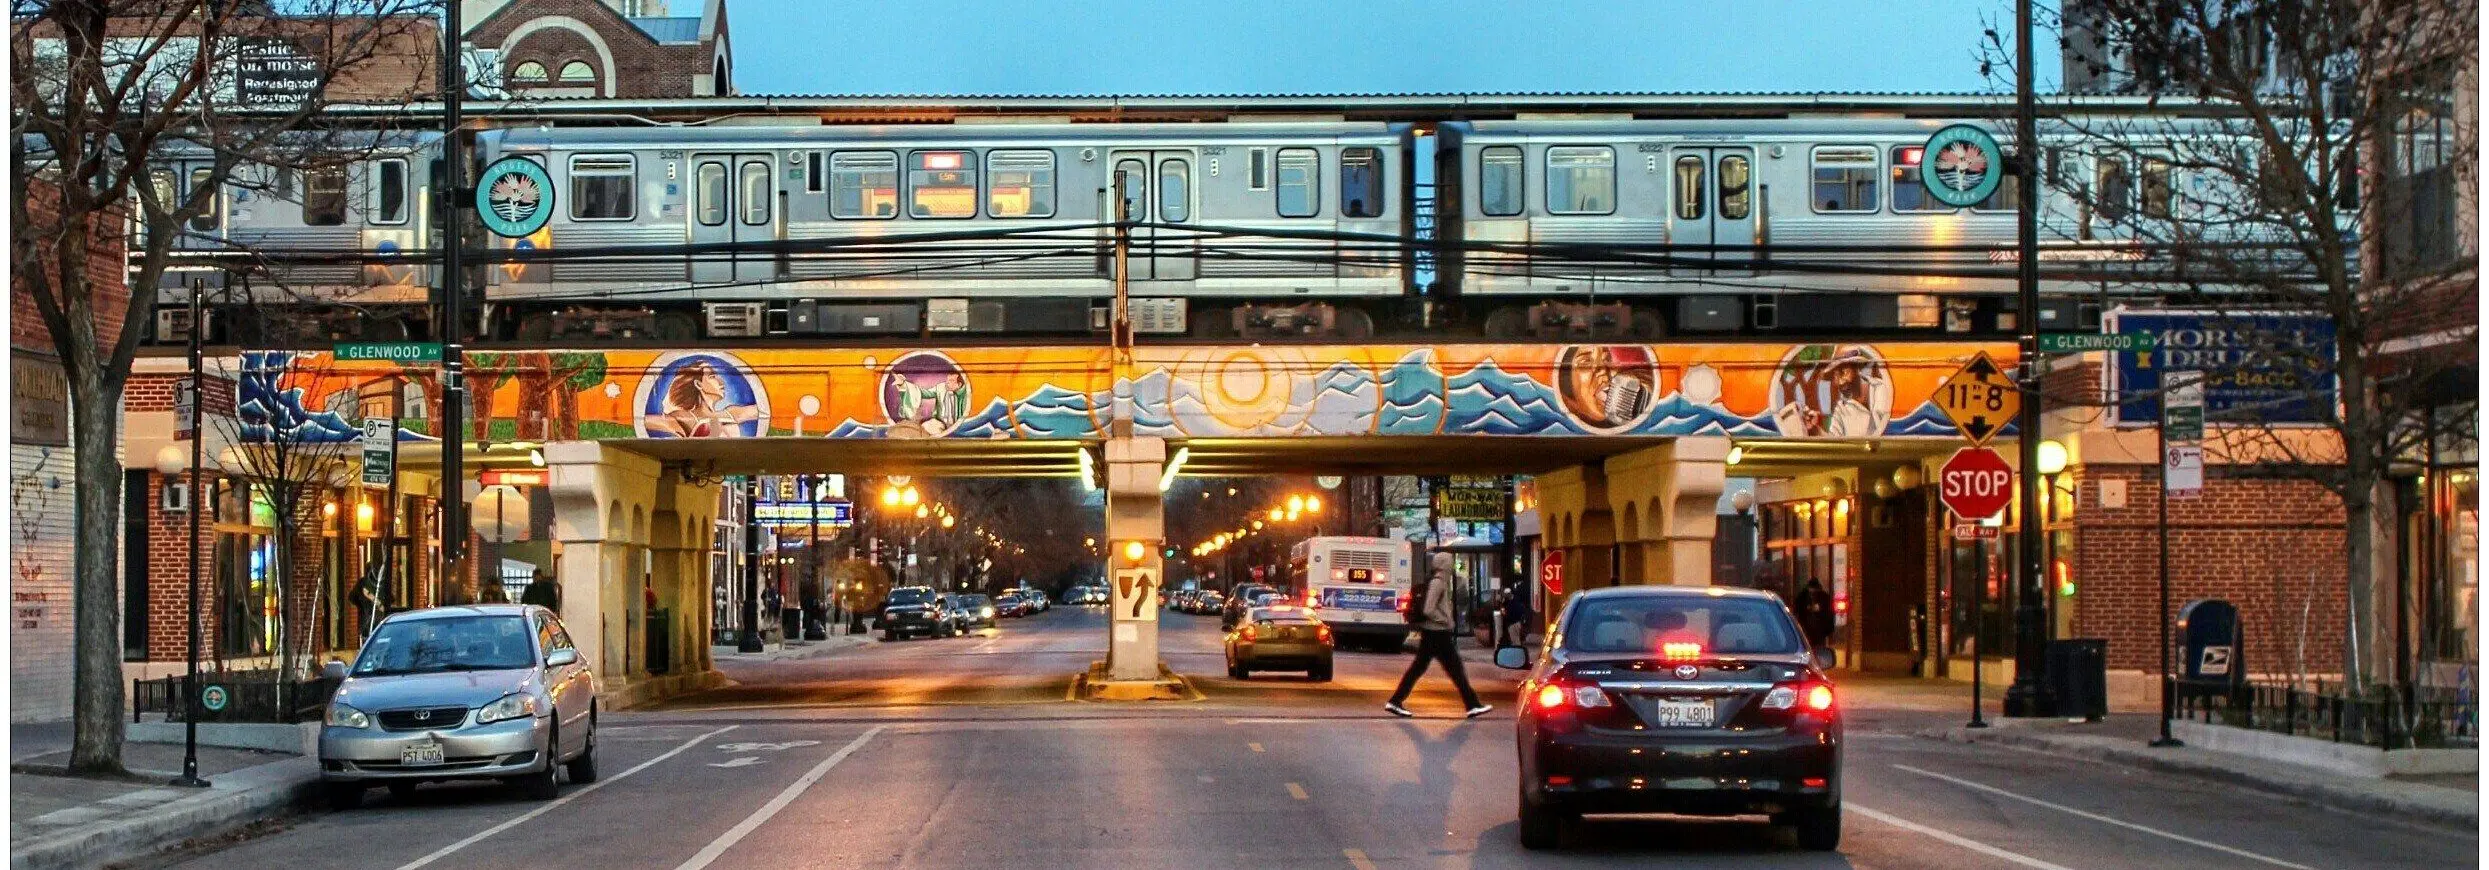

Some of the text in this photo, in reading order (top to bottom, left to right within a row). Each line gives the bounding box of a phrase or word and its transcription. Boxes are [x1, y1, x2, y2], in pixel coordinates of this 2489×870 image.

[2057, 335, 2132, 348] GLENWOOD
[349, 345, 421, 359] GLENWOOD
[427, 348, 438, 356] AV
[1945, 470, 2009, 497] STOP
[1544, 564, 1562, 581] ST
[1660, 706, 1712, 721] P99 4801
